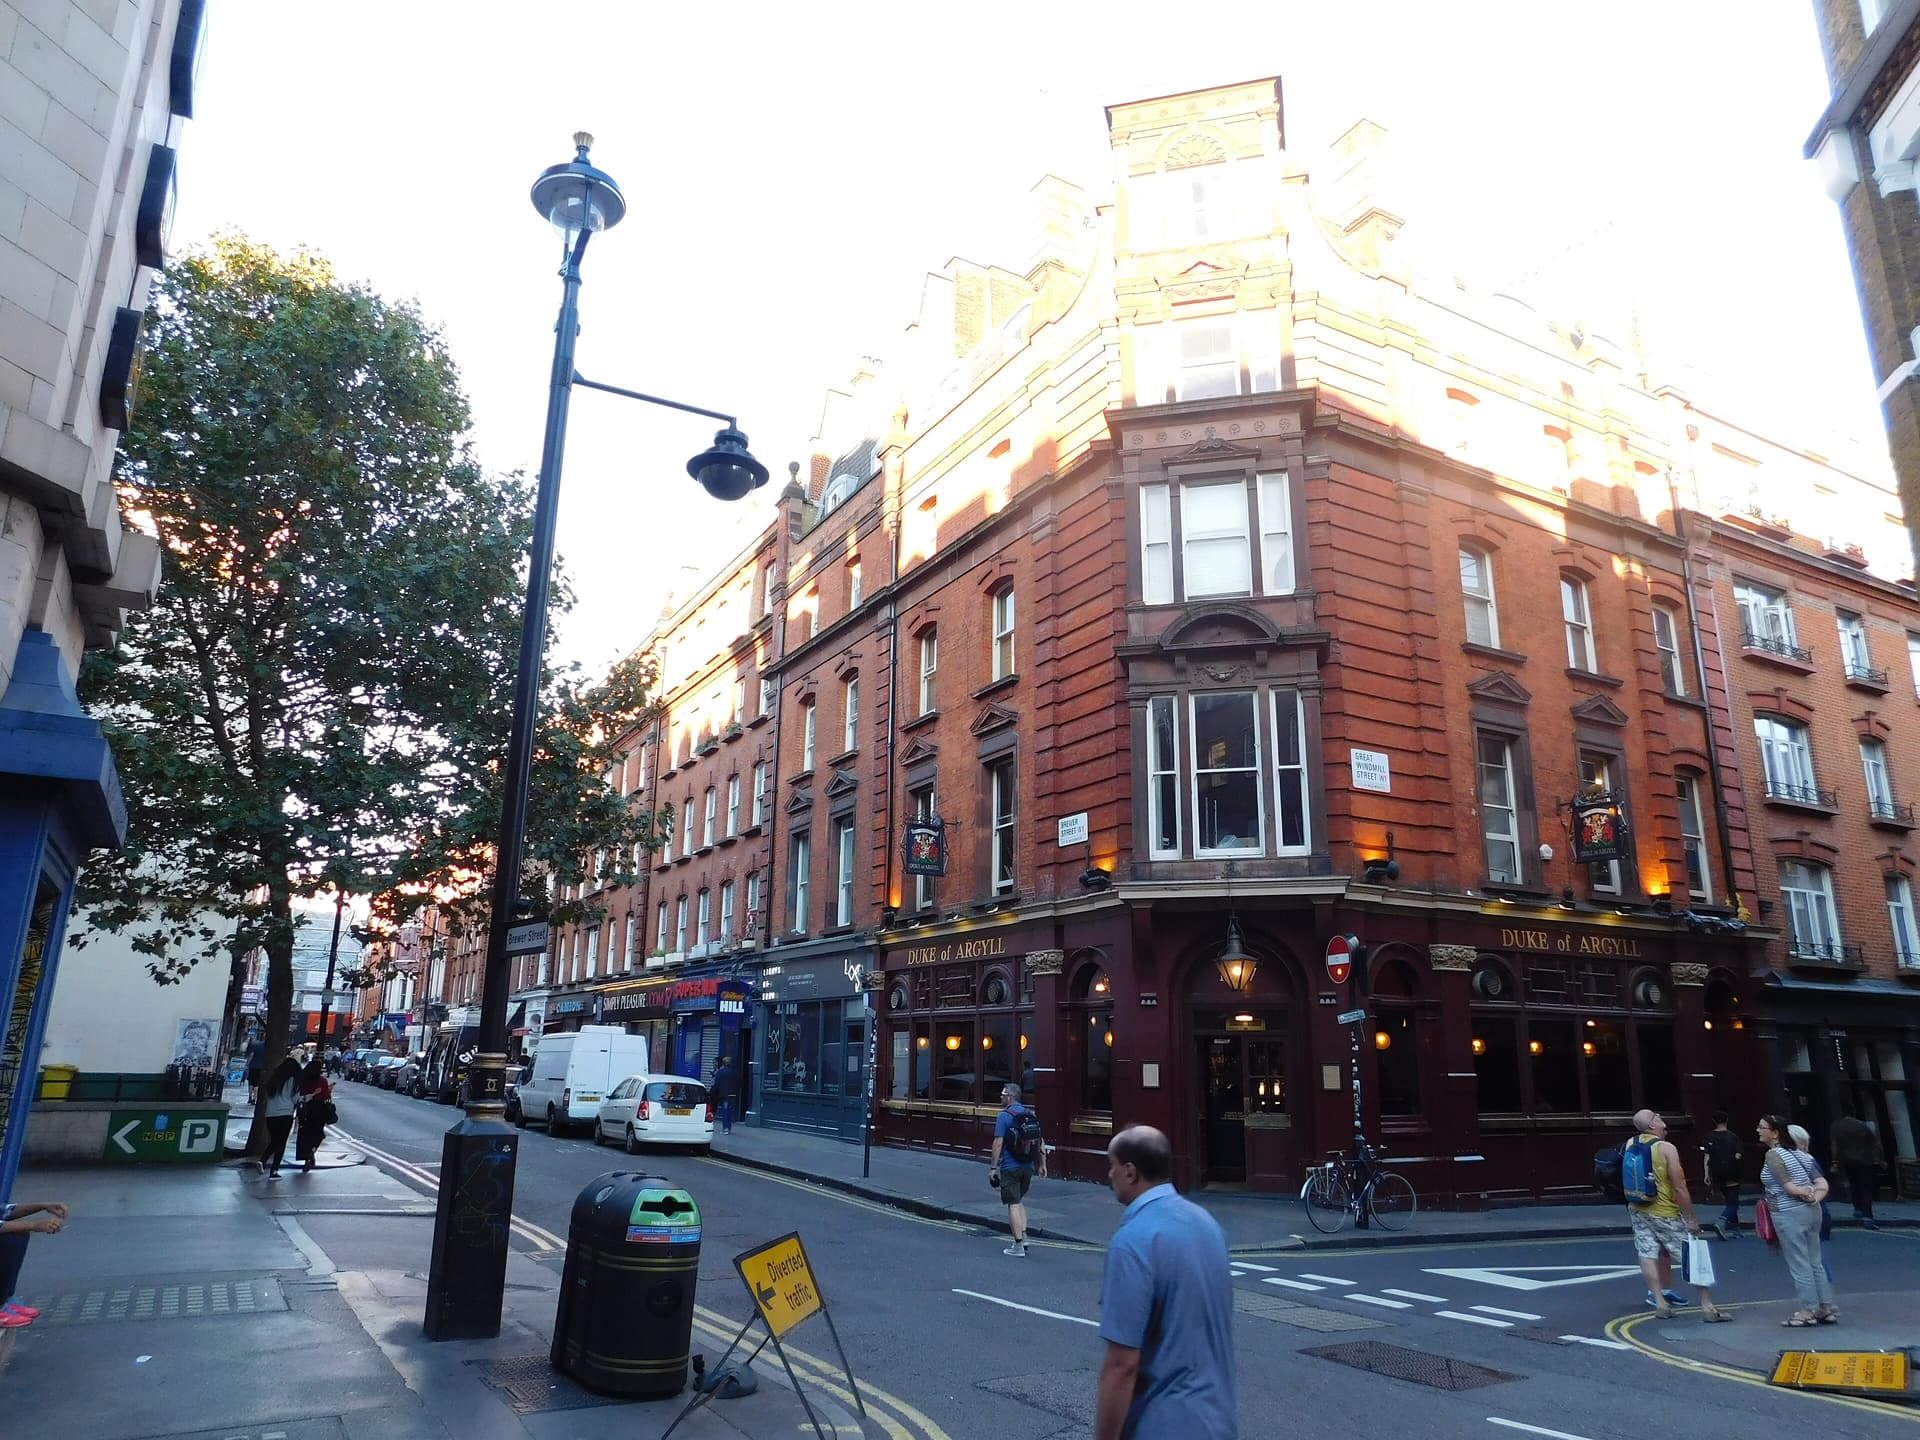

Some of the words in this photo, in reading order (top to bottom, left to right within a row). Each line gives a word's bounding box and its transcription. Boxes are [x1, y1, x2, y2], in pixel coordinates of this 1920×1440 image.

[1355, 752, 1373, 762] GREAT
[1356, 761, 1386, 773] WINDMILL
[1356, 770, 1377, 781] STREET
[1061, 818, 1079, 829] BREWER
[1061, 827, 1077, 838] STREET
[508, 933, 527, 945] Brewer
[528, 928, 546, 942] Street
[1501, 928, 1549, 950] DUKE
[1557, 933, 1571, 952] of
[1579, 935, 1642, 957] ARGYLL
[907, 947, 937, 965] DUKE
[940, 945, 952, 961] of
[955, 938, 1006, 960] ARGYLL
[603, 995, 620, 1011] SIMPLY
[719, 1000, 745, 1014] HILL
[143, 1131, 176, 1141] NCP
[186, 1122, 211, 1149] P
[766, 1248, 804, 1283] Diverted
[783, 1282, 812, 1311] traffic
